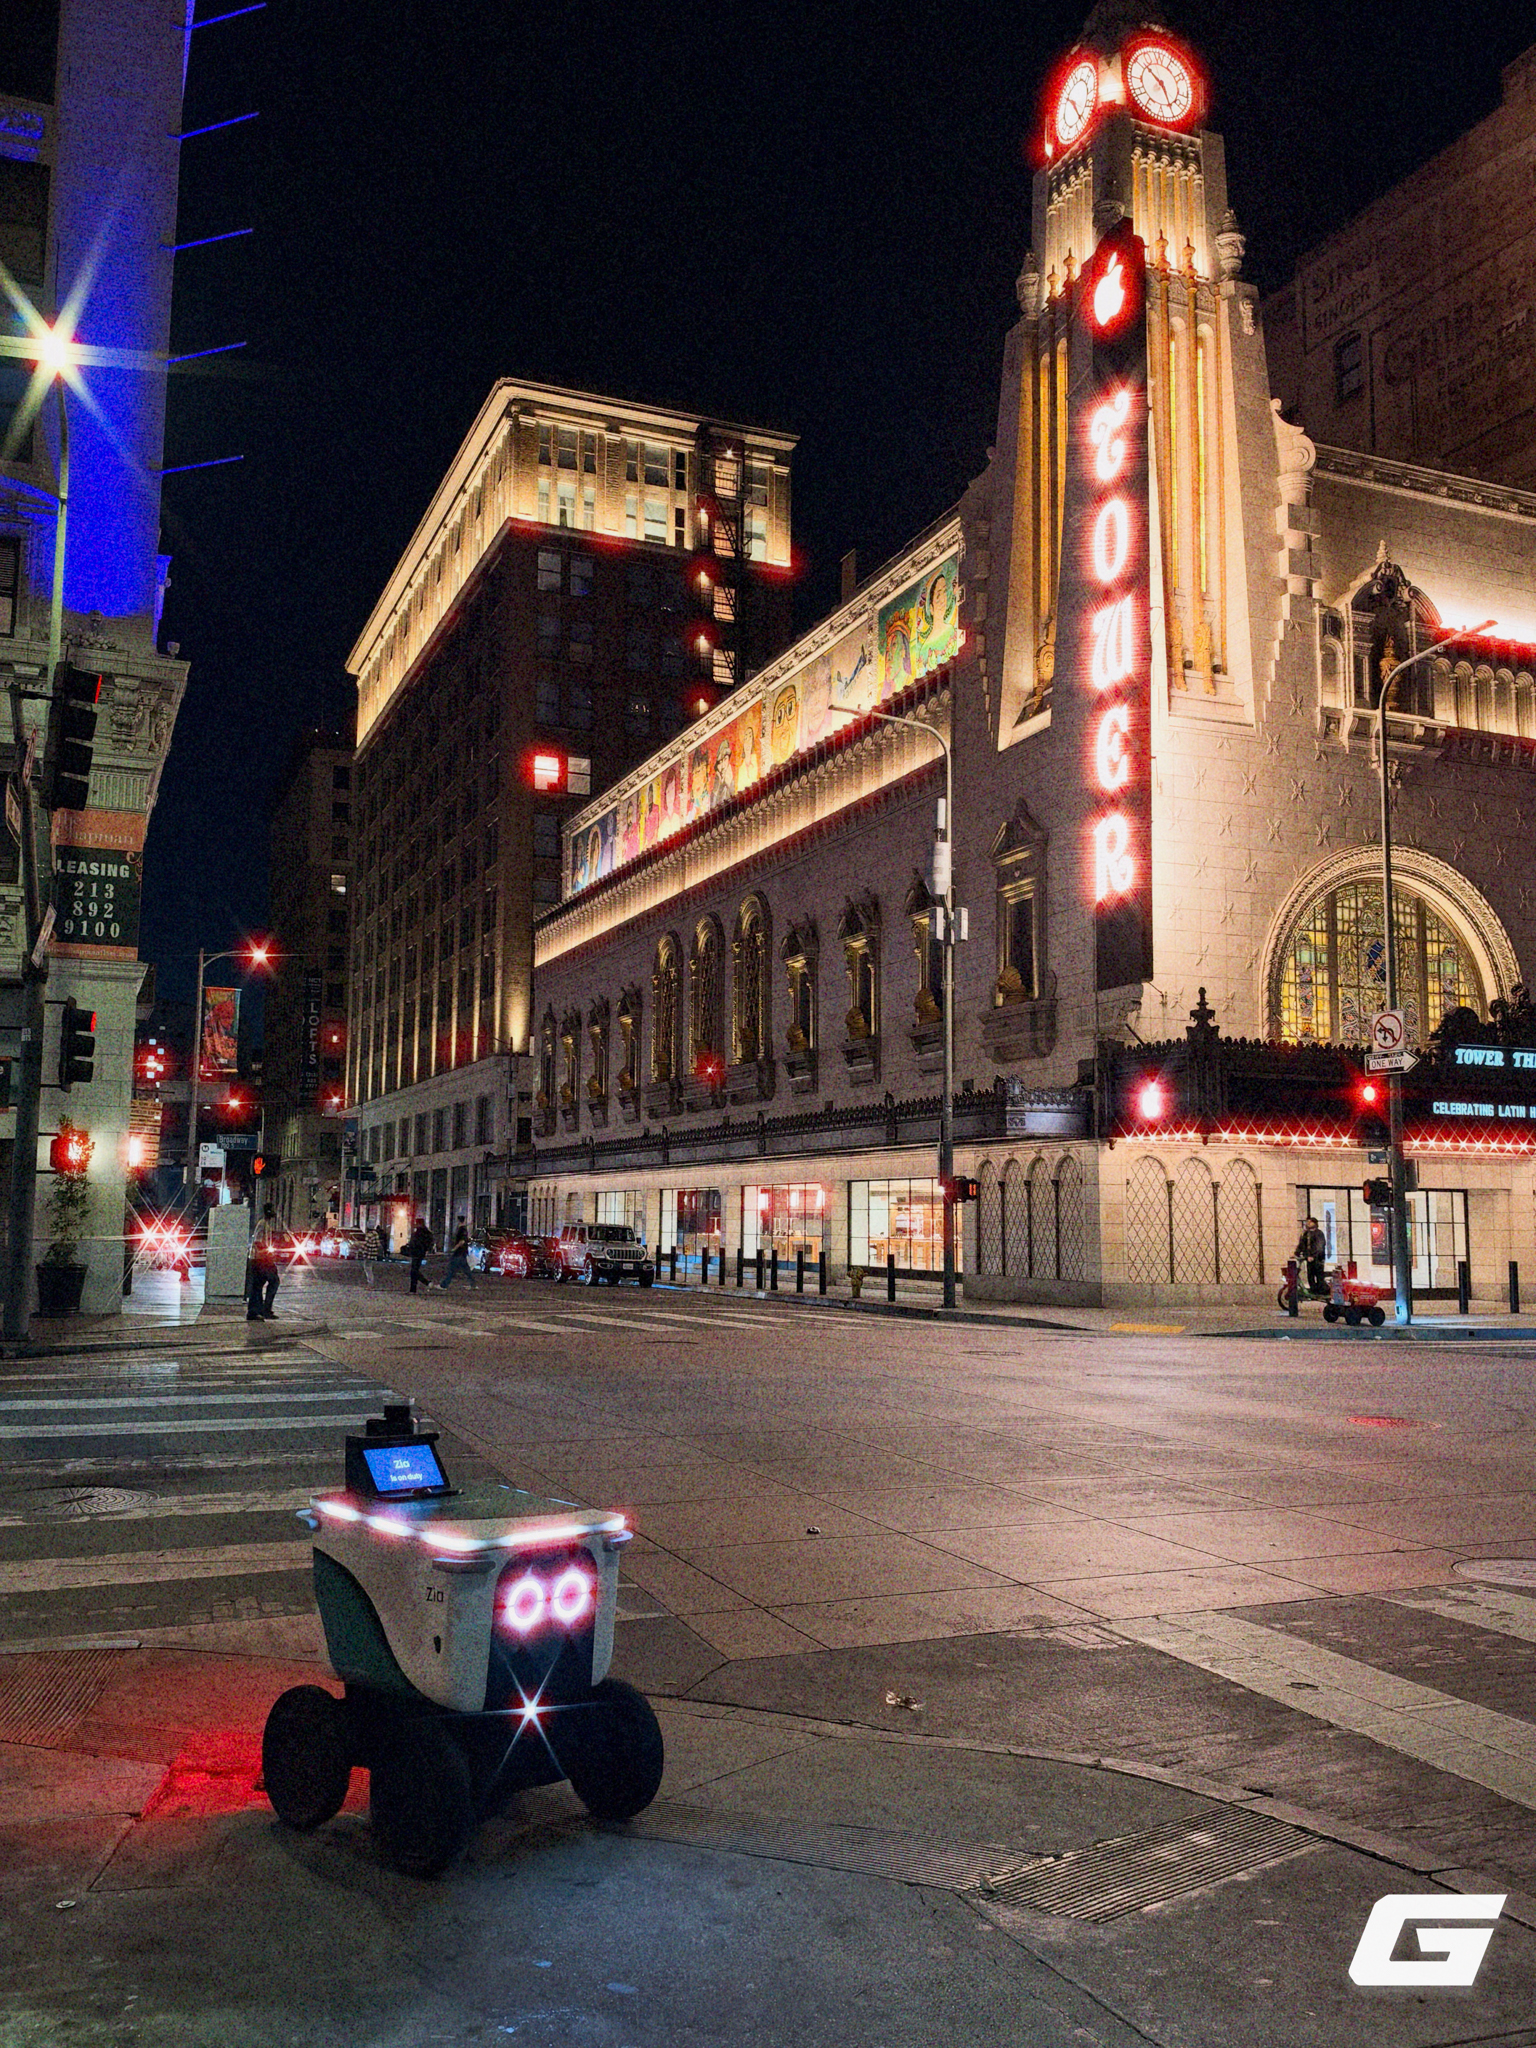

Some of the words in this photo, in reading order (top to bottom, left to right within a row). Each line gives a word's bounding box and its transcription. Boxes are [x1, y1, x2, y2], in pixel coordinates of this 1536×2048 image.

[1090, 390, 1134, 902] TOWER
[57, 859, 130, 878] LEASING
[74, 881, 115, 899] 213
[73, 900, 114, 919] 892
[64, 919, 121, 938] 9100
[308, 1002, 320, 1065] LOFTS
[1371, 1060, 1387, 1069] ONE
[1387, 1057, 1403, 1067] WAY
[1455, 1048, 1505, 1067] TOWER
[1512, 1051, 1536, 1069] TH
[1433, 1101, 1495, 1117] CELEBRATING
[1498, 1104, 1526, 1118] LATIN
[219, 1135, 249, 1146] Broadway
[393, 1459, 411, 1469] Zia
[407, 1473, 423, 1481] duty
[426, 1586, 444, 1602] Zia
